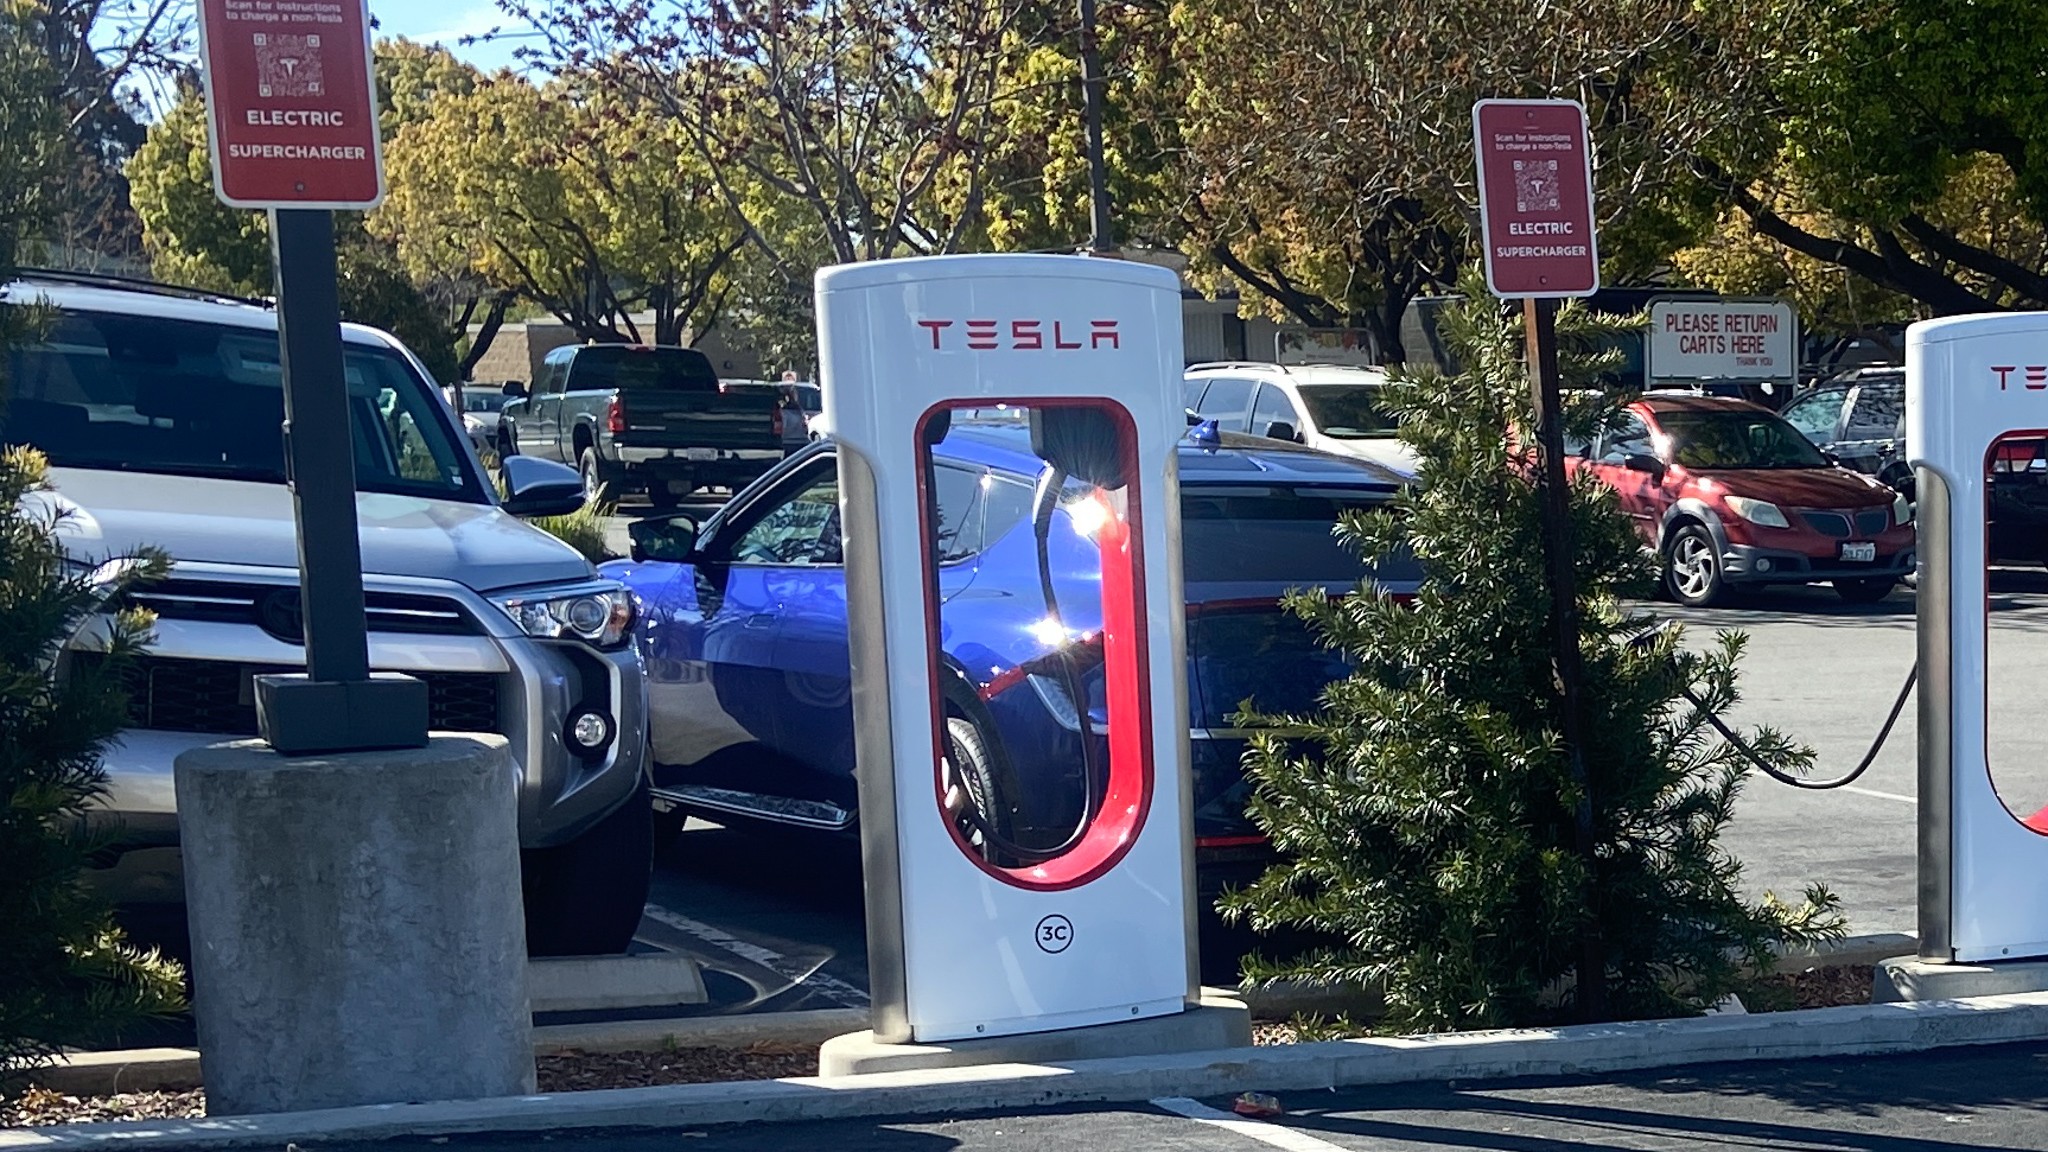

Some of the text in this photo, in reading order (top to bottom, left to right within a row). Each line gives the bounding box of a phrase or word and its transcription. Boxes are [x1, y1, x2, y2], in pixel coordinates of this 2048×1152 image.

[225, 0, 341, 12] Scan for instructions
[226, 11, 239, 20] to
[241, 12, 279, 22] charge
[291, 13, 342, 23] non-Tesla
[247, 110, 344, 126] ELECTRIC
[1515, 133, 1527, 141] for
[229, 144, 365, 160] SUPERCHARGER
[1509, 222, 1573, 235] ELECTRIC
[1497, 245, 1586, 257] SUPERCHARGER
[1666, 314, 1778, 333] PLEASE RETURN
[917, 320, 1120, 350] TESLA
[1680, 335, 1765, 354] CARTS HERE
[1736, 356, 1773, 366] THANK YOU
[1042, 925, 1067, 941] 3C
